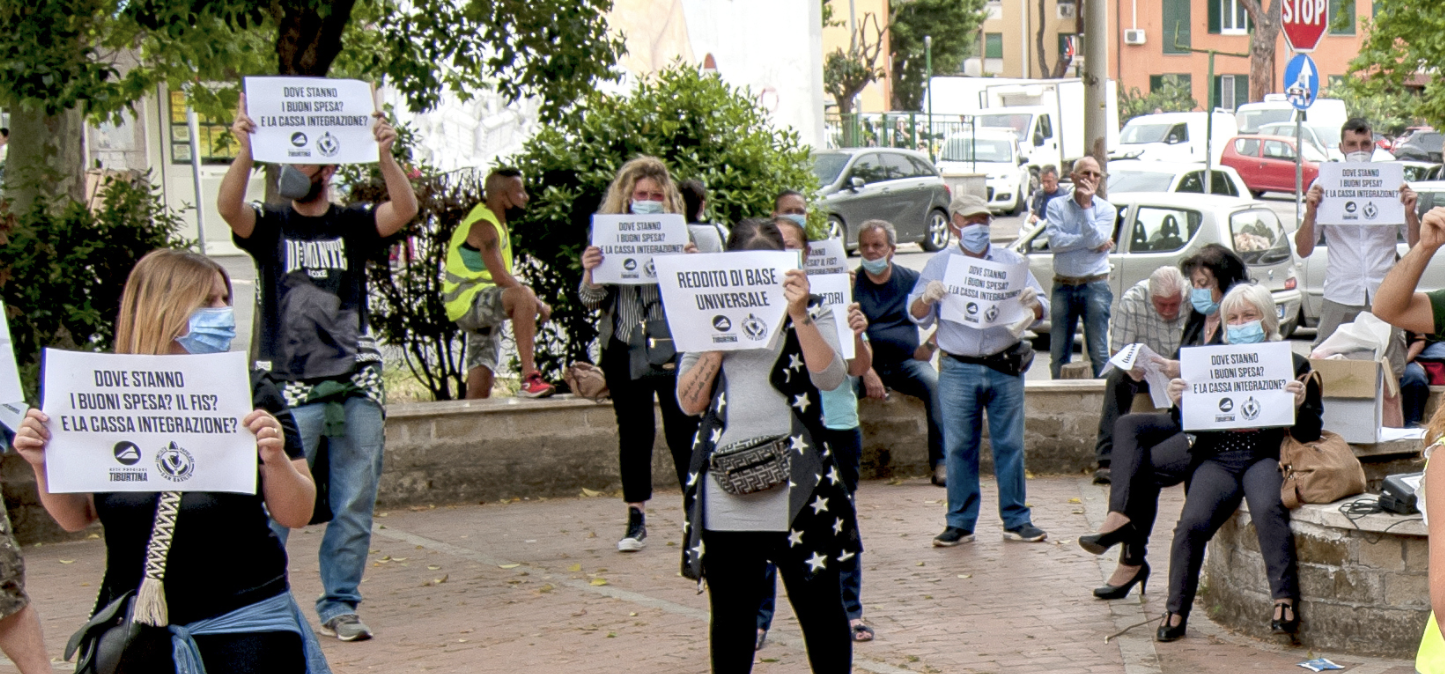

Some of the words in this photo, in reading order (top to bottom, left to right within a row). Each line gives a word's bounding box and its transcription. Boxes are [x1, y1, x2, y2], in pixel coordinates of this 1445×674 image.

[1282, 0, 1326, 26] STOP
[284, 86, 304, 98] DOVE
[306, 87, 338, 98] STANNO
[282, 102, 285, 112] I
[287, 102, 312, 112] BUONI
[314, 101, 344, 112] SPESA?
[261, 116, 265, 127] E
[267, 116, 277, 127] LA
[279, 116, 305, 126] CASSA
[307, 115, 368, 126] INTEGRAZIONE?
[1342, 169, 1356, 177] DOVE
[1357, 169, 1380, 177] STANNO
[1362, 179, 1383, 187] SPESA?
[1357, 190, 1399, 198] INTEGRAZIONE?
[619, 222, 635, 231] DOVE
[637, 222, 661, 231] STANNO
[617, 234, 619, 242] I
[621, 234, 640, 242] BUONI
[642, 233, 665, 242] SPESA?
[605, 245, 613, 254] LA
[614, 245, 635, 254] CASSA
[677, 270, 728, 288] REDDITO
[731, 269, 743, 286] DI
[747, 268, 778, 286] BASE
[968, 265, 983, 276] DOVE
[983, 268, 1006, 279] STANNO
[967, 277, 985, 288] BUONI
[986, 281, 1009, 290] SPESA?
[948, 285, 952, 293] E
[952, 285, 959, 294] LA
[960, 286, 979, 298] CASSA
[695, 291, 770, 310] UNIVERSALE
[1211, 354, 1230, 366] DOVE
[1231, 353, 1259, 364] STANNO
[94, 370, 129, 387] DOVE
[132, 371, 184, 388] STANNO
[1210, 370, 1213, 379] I
[1215, 368, 1237, 379] BUONI
[1238, 366, 1264, 377] SPESA?
[1193, 385, 1197, 394] E
[1199, 384, 1208, 394] LA
[1209, 382, 1232, 393] CASSA
[1234, 379, 1287, 392] INTEGRAZIONE?
[70, 393, 75, 409] I
[79, 393, 121, 410] BUONI
[124, 394, 172, 410] SPESA?
[176, 394, 189, 411] IL
[192, 394, 218, 411] FIS?
[61, 416, 70, 431] E
[71, 416, 88, 432] LA
[91, 416, 135, 432] CASSA
[139, 416, 237, 433] INTEGRAZIONE?
[109, 472, 148, 482] TIBURTINA
